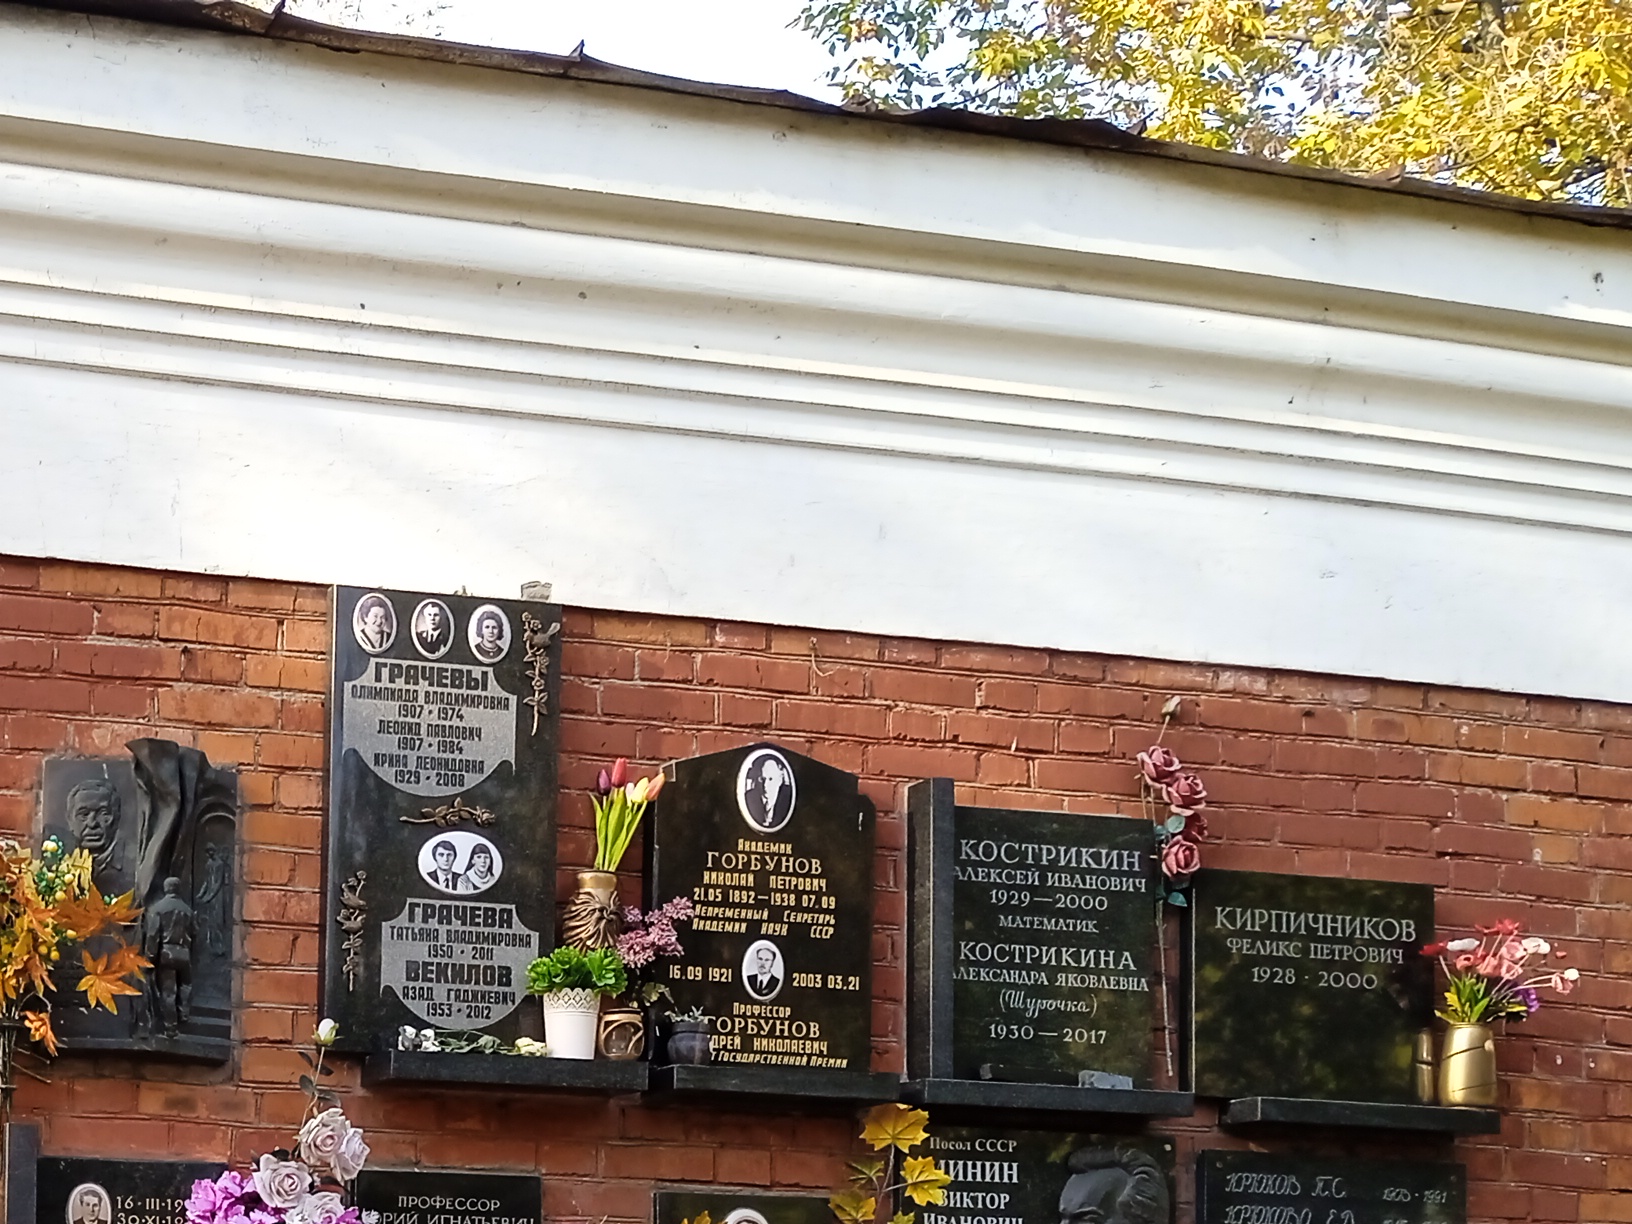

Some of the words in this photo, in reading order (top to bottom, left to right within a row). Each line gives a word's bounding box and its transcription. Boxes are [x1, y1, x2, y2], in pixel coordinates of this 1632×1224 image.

[374, 662, 489, 691] ГРАЧЕВЫ
[351, 685, 418, 701] ОЛИМПИАДА
[425, 691, 509, 711] ВЛАДИМИРОВНА
[377, 720, 421, 735] ЛЕОНИД
[427, 725, 482, 741] ПАВЛОВИЧ
[374, 753, 408, 768] ИРИНА
[415, 757, 484, 774] ЛЕОНИДОВНА
[707, 852, 822, 874] ГОРБУНОВ
[960, 839, 1140, 871] КОСТРИКИН
[704, 871, 754, 887] НИКОЛАЙ
[770, 876, 827, 892] ПЕТРОВИЧ
[954, 866, 1039, 885] АЛЕКСЕЙ
[1047, 872, 1147, 892] ИВАНОВИЧ
[408, 903, 513, 929] ГРАЧЕВА
[998, 915, 1099, 933] МАТЕМАТИК
[1215, 906, 1416, 942] КИРПИЧНИКОВ
[390, 926, 439, 943] ТАТЬЯНА
[446, 931, 531, 948] ВЛАДИМИРОВНА
[959, 941, 1137, 971] КОСТРИКИНА
[1226, 938, 1303, 958] ФЕЛИКС
[1309, 943, 1403, 964] ПЕТРОВИЧ
[406, 960, 512, 987] ВЕКИЛОВ
[1056, 975, 1149, 991] ЯКОВЛЕВНА
[402, 986, 434, 1001] АЗАД
[447, 989, 516, 1005] ГАДЖИЕВИЧ
[754, 1038, 827, 1055] НИКОЛАЕВИЧ
[930, 1137, 971, 1151] Посол
[975, 1138, 1017, 1152] СССР
[398, 1195, 501, 1212] ПРОФЕССОР
